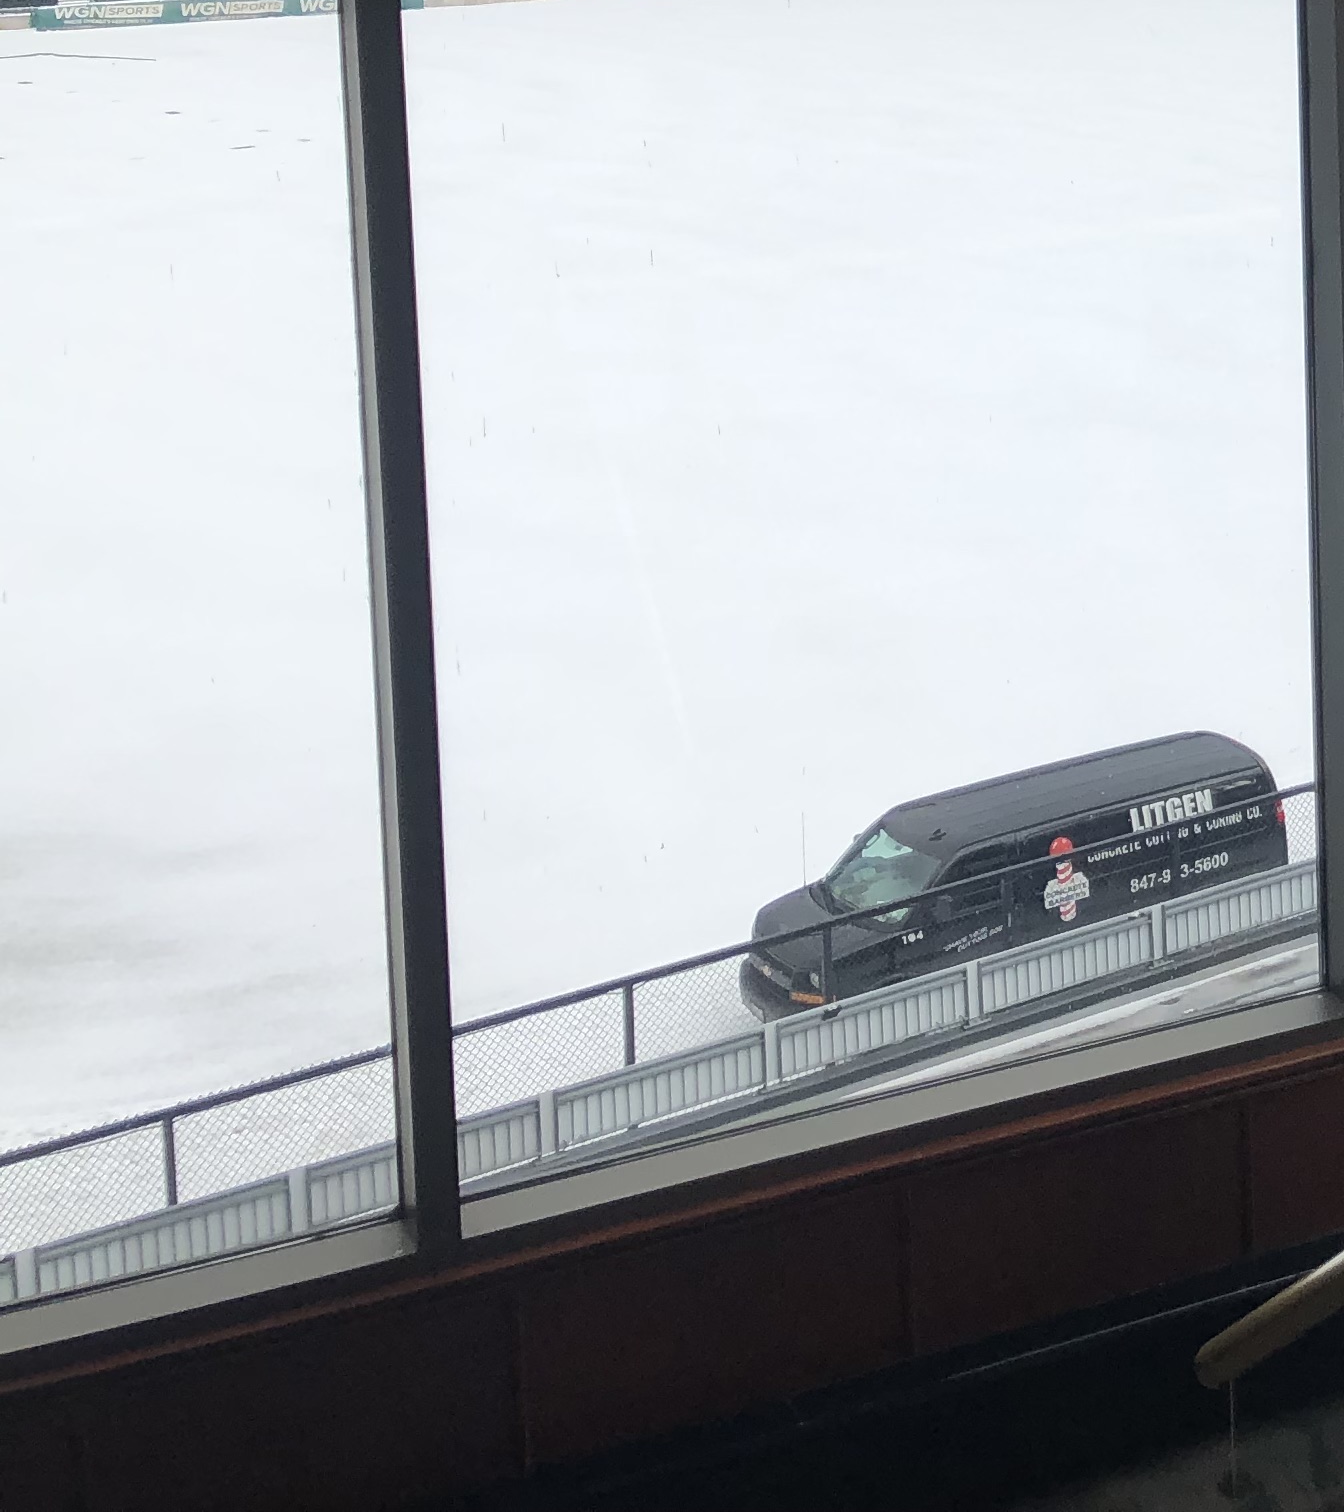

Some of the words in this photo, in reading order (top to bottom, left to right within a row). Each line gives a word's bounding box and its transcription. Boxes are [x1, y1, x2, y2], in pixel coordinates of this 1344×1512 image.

[55, 5, 105, 19] WGN
[108, 5, 160, 17] SPORTS
[180, 2, 231, 17] WGN
[233, 0, 280, 13] SPORTS
[1129, 788, 1214, 833] LITGEN
[1130, 852, 1229, 893] 847-93-5600
